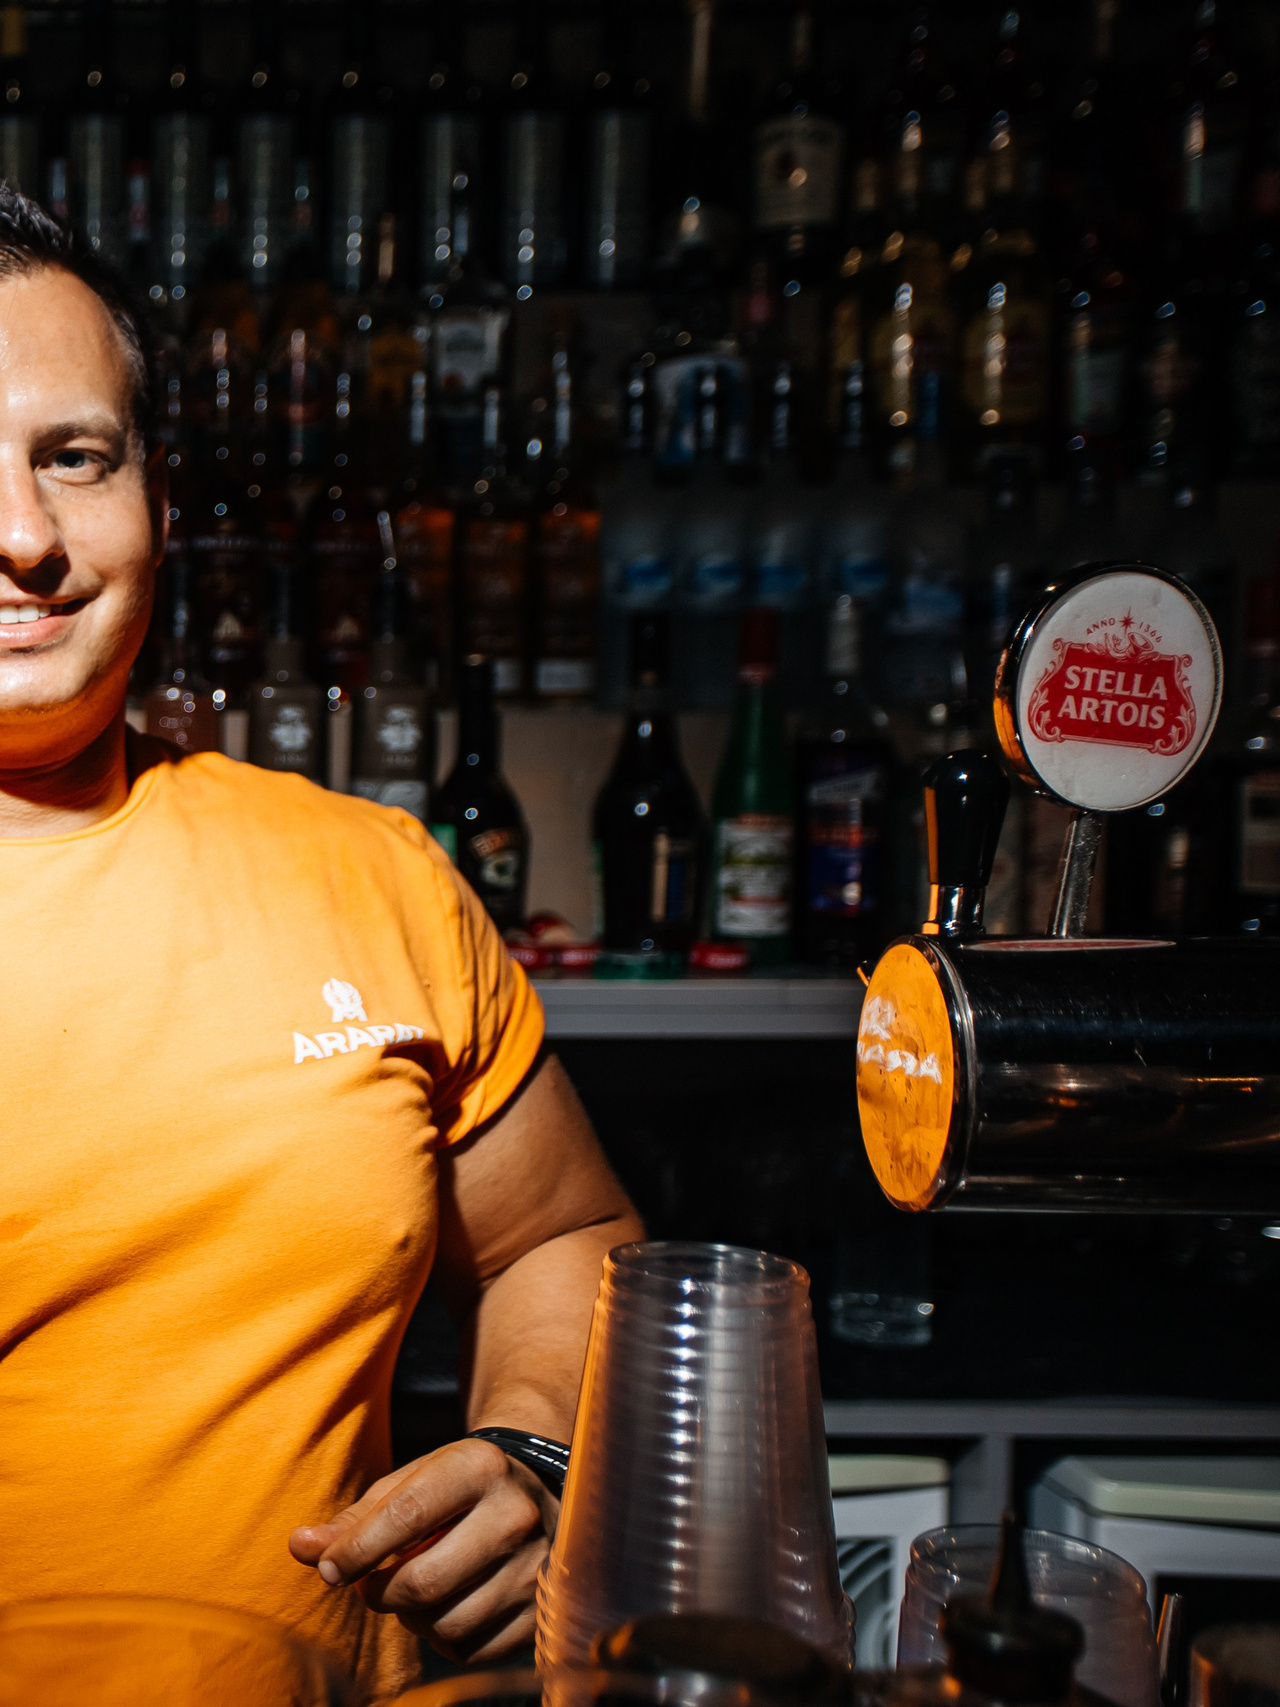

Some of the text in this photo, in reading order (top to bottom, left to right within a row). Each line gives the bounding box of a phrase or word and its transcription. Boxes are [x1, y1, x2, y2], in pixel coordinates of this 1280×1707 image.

[1085, 617, 1163, 643] ANNO 1366
[1063, 664, 1168, 701] STELLA
[1057, 694, 1166, 730] ARTOIS
